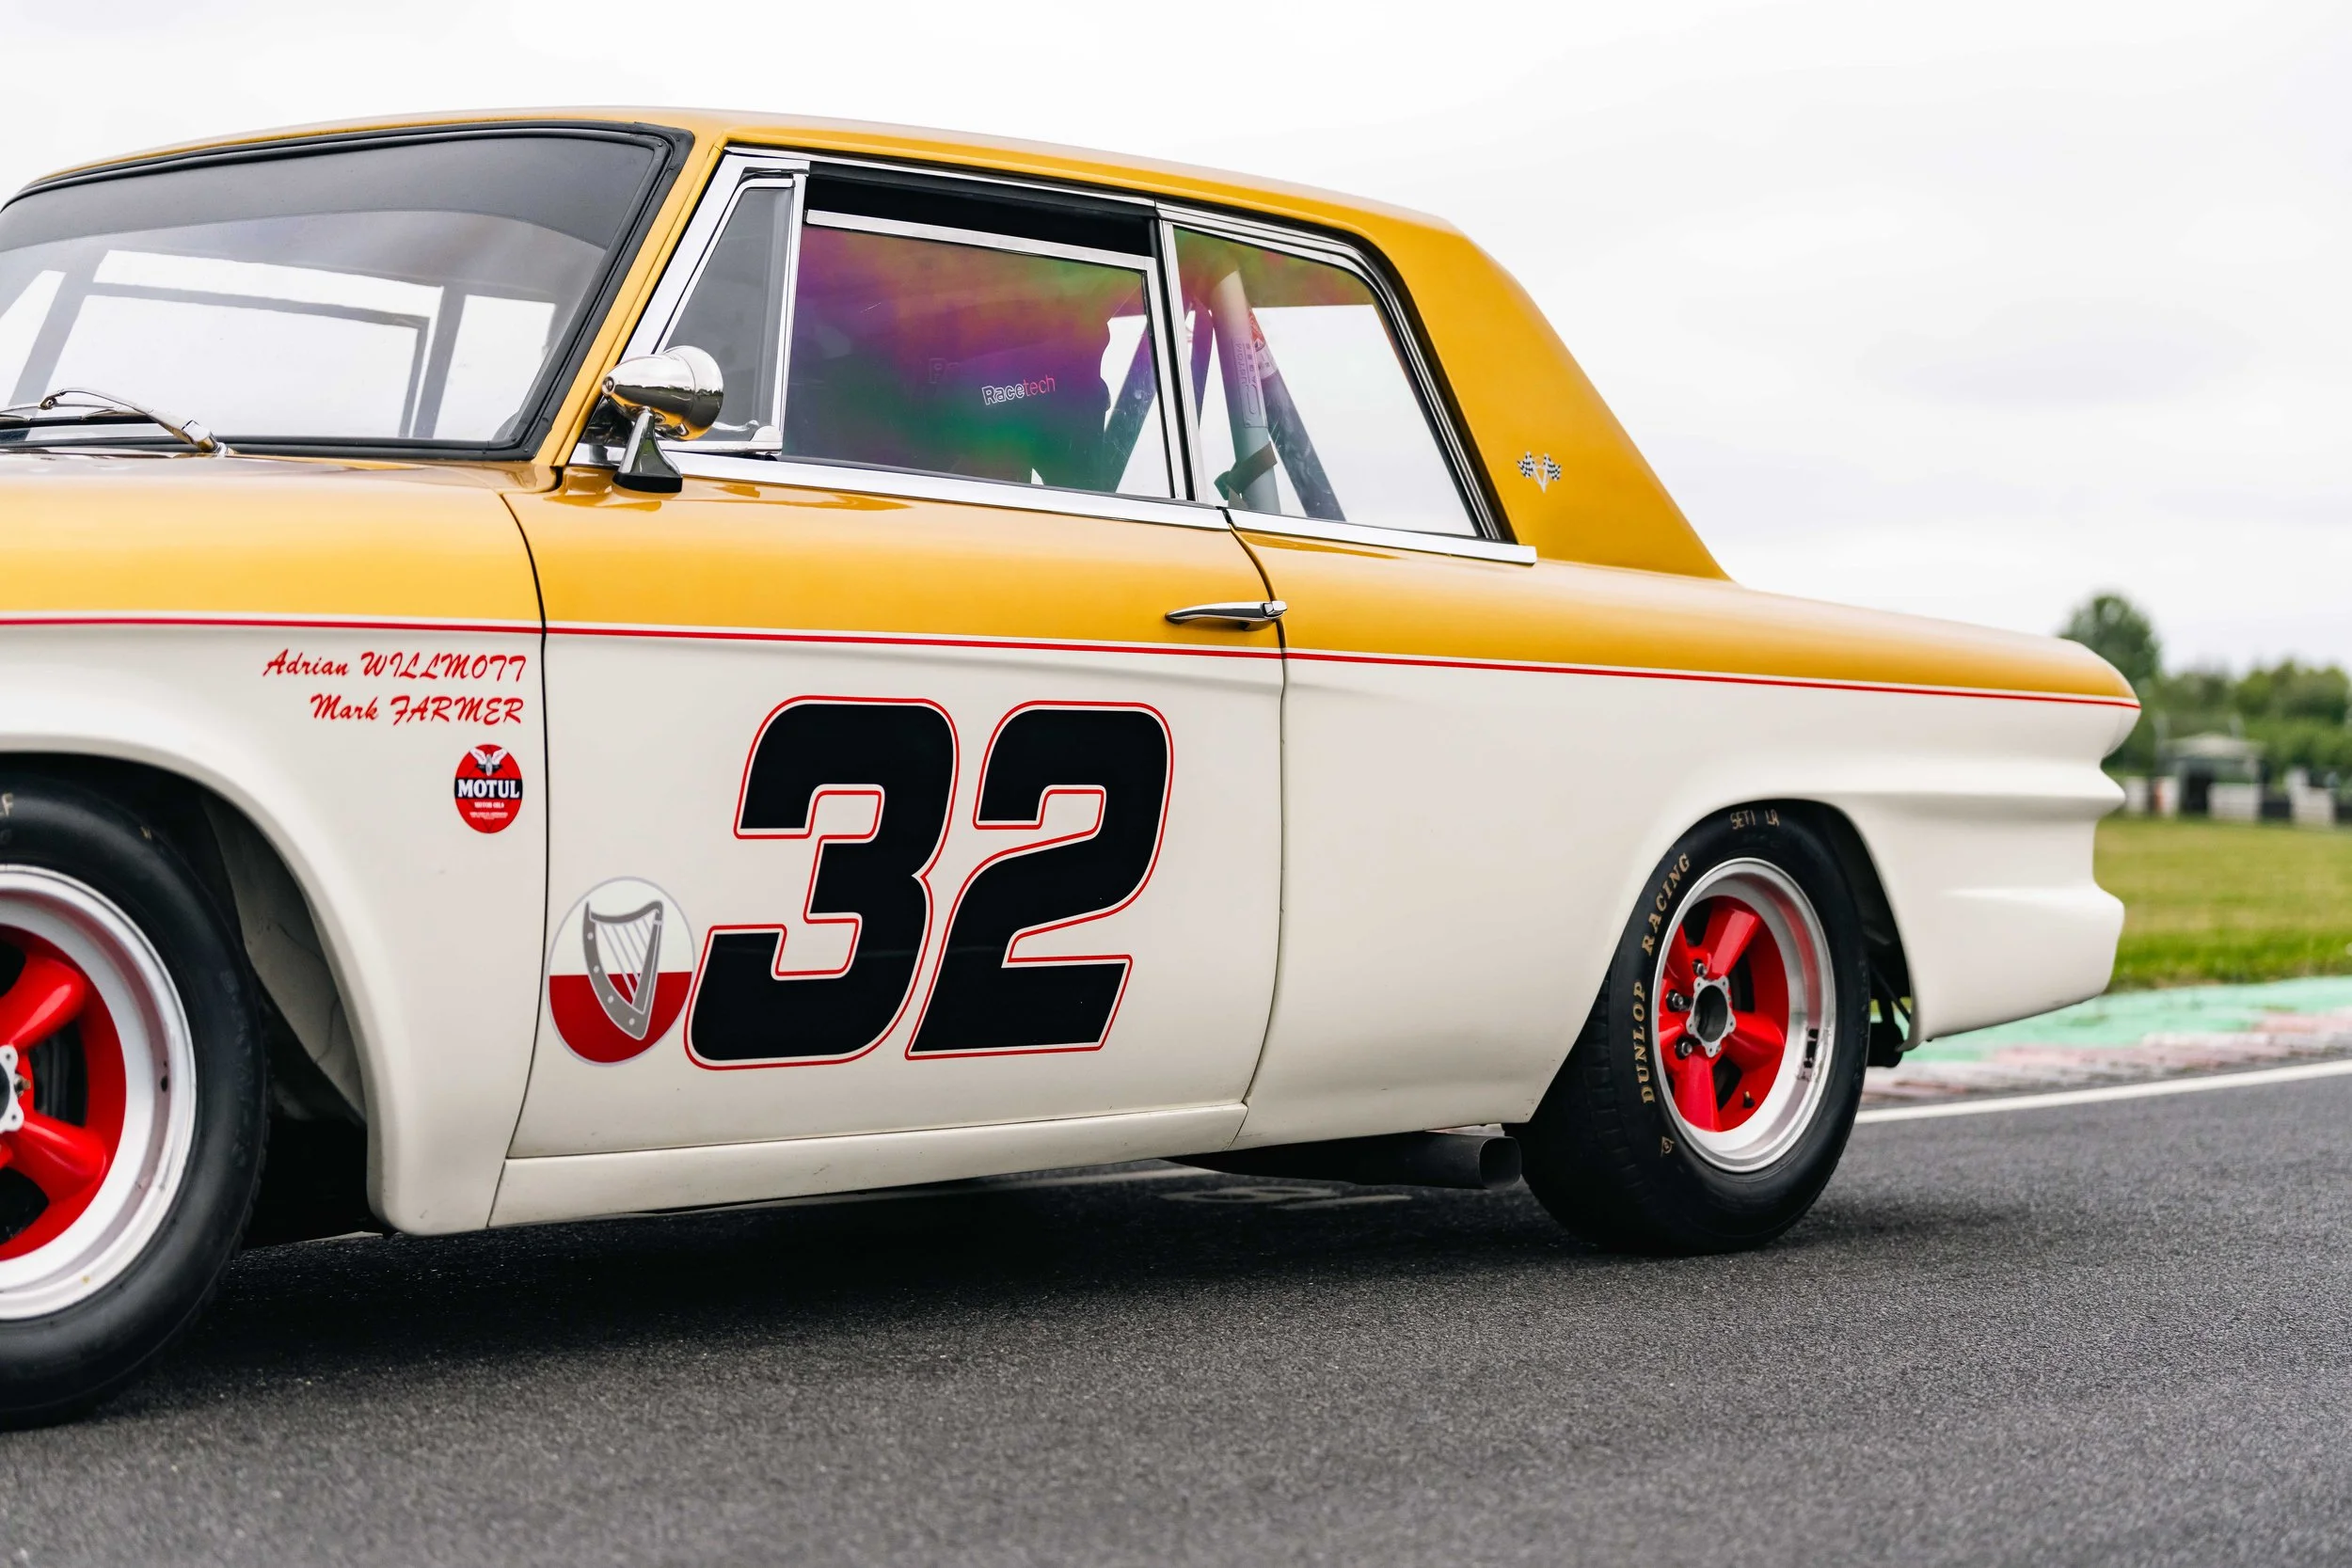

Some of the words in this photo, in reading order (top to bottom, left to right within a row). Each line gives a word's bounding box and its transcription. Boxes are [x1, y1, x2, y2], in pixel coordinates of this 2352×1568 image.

[981, 374, 1056, 405] Racetech
[262, 648, 349, 676] Adrian
[360, 651, 527, 682] WILLMOTT
[310, 693, 378, 721] Mark
[389, 695, 524, 725] FARMER
[0, 792, 13, 817] F
[457, 779, 520, 799] MOTUL
[684, 695, 1174, 1070] 32
[1641, 852, 1690, 957] RACING
[1632, 981, 1655, 1103] DUNLOP
